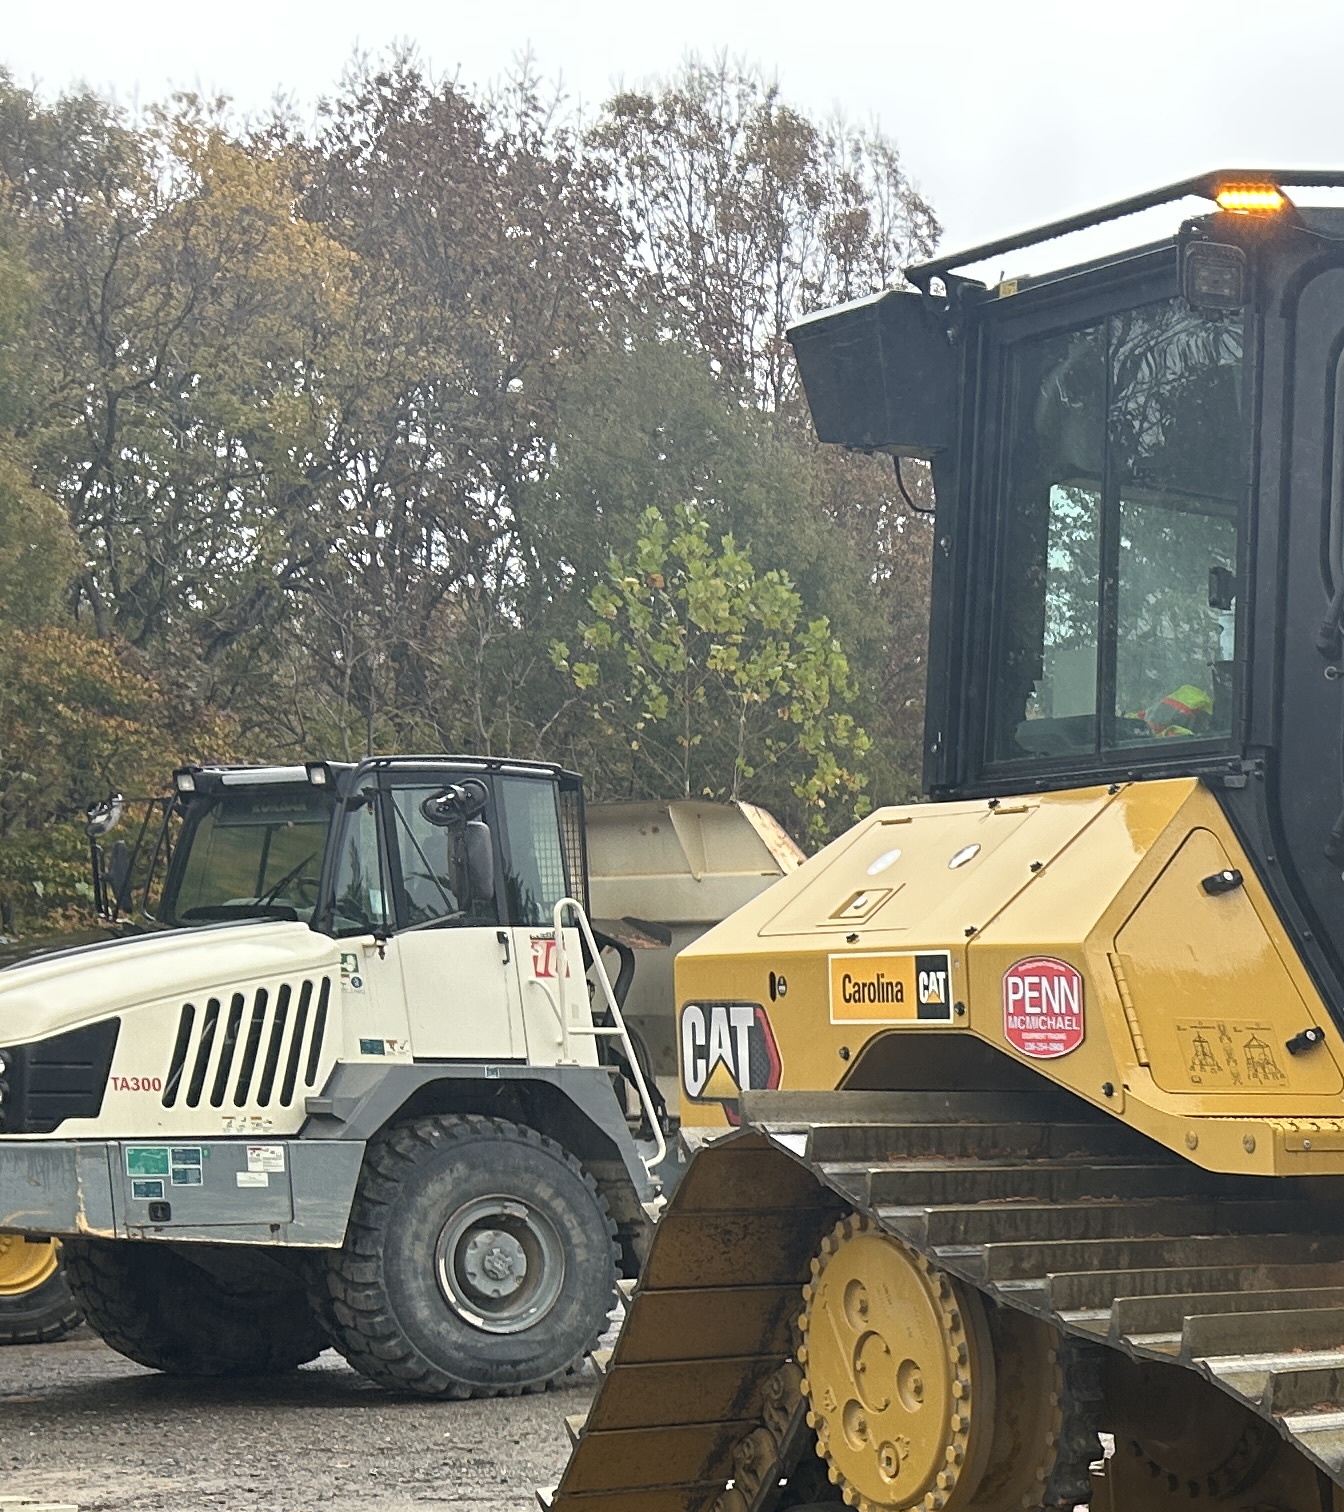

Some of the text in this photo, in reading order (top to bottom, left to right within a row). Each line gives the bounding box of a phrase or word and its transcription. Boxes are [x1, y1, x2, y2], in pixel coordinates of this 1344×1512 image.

[842, 971, 946, 1004] Carolina CAT
[1007, 976, 1080, 1014] PENN
[1007, 1015, 1080, 1030] MCMICHAEL
[682, 1005, 754, 1098] CAT
[110, 1077, 162, 1092] TA300
